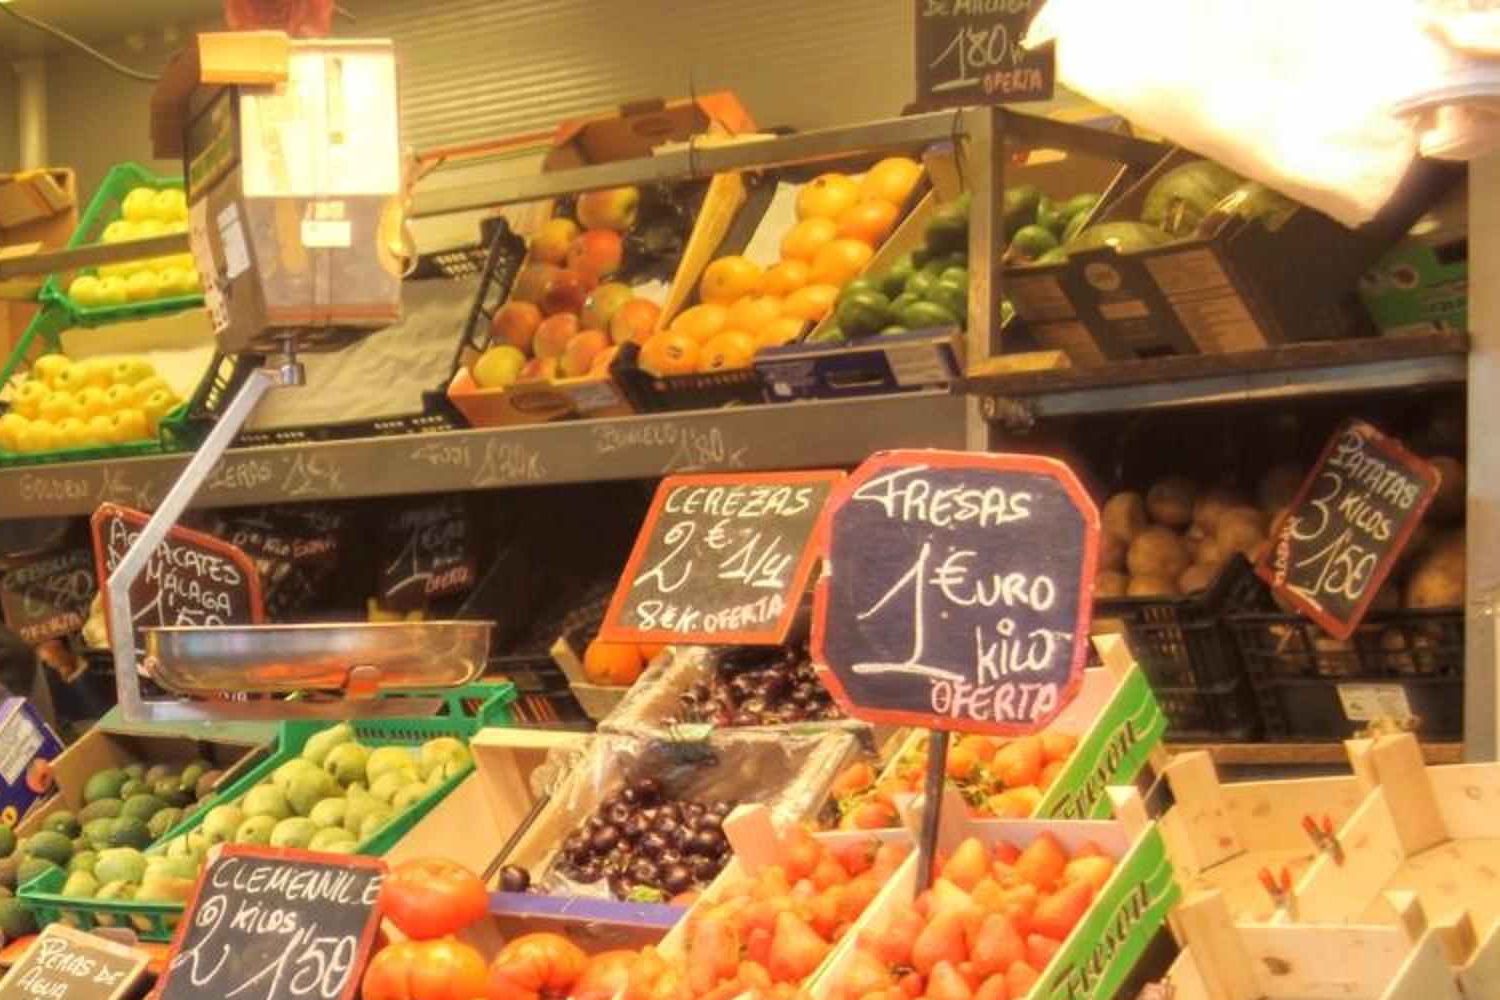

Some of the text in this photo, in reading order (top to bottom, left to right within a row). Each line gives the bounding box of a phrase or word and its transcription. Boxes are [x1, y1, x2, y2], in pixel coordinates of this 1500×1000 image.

[982, 67, 1044, 95] OFERTA
[18, 474, 90, 502] GOLDEN
[851, 464, 1033, 528] FRESAS
[1327, 430, 1419, 509] PATATAS
[665, 483, 813, 518] CEREZAS
[1289, 472, 1394, 541] 3 KILOS
[110, 517, 242, 586] AGACATES
[718, 532, 793, 588] 1/4
[703, 593, 787, 634] OFERTA
[851, 541, 965, 682] 1
[931, 679, 1059, 721] OFERTA
[168, 893, 300, 987] 2 KILOS
